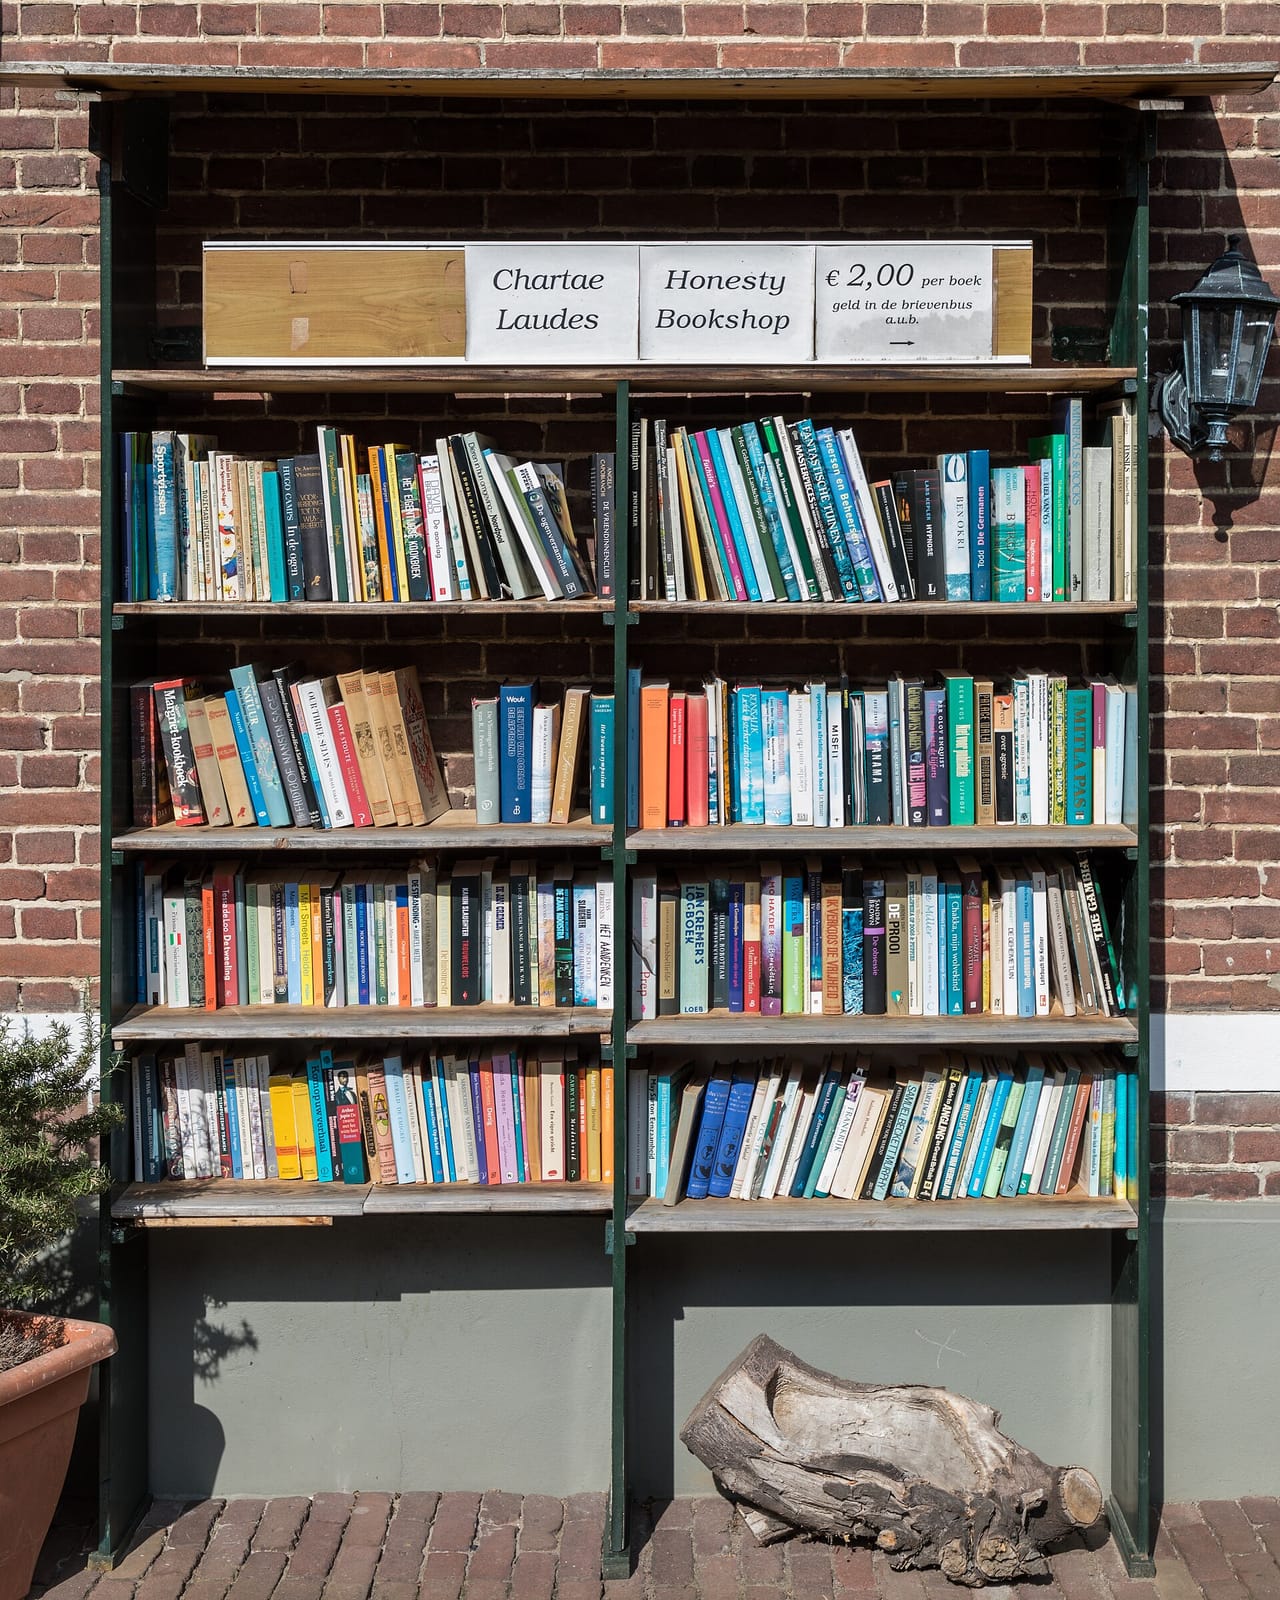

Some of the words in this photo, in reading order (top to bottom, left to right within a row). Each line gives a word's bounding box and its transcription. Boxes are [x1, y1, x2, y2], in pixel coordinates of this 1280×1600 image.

[494, 269, 604, 290] Chartae
[665, 270, 785, 295] Honesty
[825, 270, 839, 286] €
[847, 264, 913, 290] 2,00
[922, 279, 944, 288] per
[950, 276, 981, 285] boek
[496, 308, 598, 329] Laudes
[833, 300, 859, 312] geld
[866, 301, 875, 309] in
[882, 300, 896, 309] de
[902, 300, 972, 309] brievenbus
[656, 309, 789, 334] Bookshop
[886, 315, 918, 324] a.u.b.
[1072, 405, 1080, 458] MINERALS
[156, 446, 167, 515] Sportvissen
[283, 466, 291, 490] HUGO
[403, 477, 412, 491] HET
[703, 459, 716, 488] Fuchsia's
[741, 449, 752, 475] Geldersch
[748, 477, 760, 506] Landschap
[794, 444, 815, 503] MASTERPIECES
[801, 426, 828, 502] FANTASTISCHE
[823, 504, 841, 544] TUINEN
[425, 480, 433, 514] BALDACCI
[431, 480, 441, 513] DAVID
[823, 434, 841, 475] Heersen
[837, 478, 845, 490] en
[841, 493, 861, 546] Beheersen
[1072, 470, 1081, 505] ROCKS
[285, 493, 293, 521] CAMPS
[404, 494, 417, 538] EIGENTIJDSE
[603, 501, 609, 510] DE
[956, 496, 964, 517] BEN
[287, 526, 297, 536] In
[433, 520, 440, 529] De
[1006, 513, 1016, 562] BYRON
[286, 539, 299, 551] de
[435, 531, 443, 559] aanslag
[536, 505, 544, 516] De
[540, 517, 569, 577] ogenverzamelaar
[288, 553, 299, 576] ogen
[410, 541, 420, 579] KOOKBOEK
[977, 550, 985, 568] Todd
[245, 685, 259, 726] NATUUR
[308, 691, 318, 709] OUR
[567, 697, 577, 723] ERICA
[908, 687, 920, 710] GEORGE
[979, 694, 990, 720] PALACE
[311, 711, 323, 737] THREE
[750, 693, 758, 734] KONSALIK
[817, 722, 822, 730] en
[908, 711, 921, 730] DAWES
[163, 690, 188, 787] Margriet-kookboek
[334, 709, 345, 736] RENATE
[340, 737, 352, 763] STOUTE
[564, 725, 572, 748] JONG
[908, 731, 922, 751] GREEN
[980, 722, 990, 743] WALK
[1074, 708, 1086, 770] MITLA
[320, 739, 331, 769] SELVES
[872, 740, 882, 783] PANAMA
[1000, 753, 1008, 779] agressie
[910, 763, 925, 781] THE
[908, 782, 925, 807] JUROR
[1074, 775, 1086, 808] PAS
[496, 886, 504, 894] IK
[496, 895, 504, 904] JAN
[695, 886, 704, 907] JAN
[791, 880, 800, 921] WALTERS
[924, 883, 933, 902] Sue
[578, 900, 586, 928] SLAUGHTER
[685, 886, 694, 944] LOGBOEK
[827, 900, 838, 909] IK
[889, 904, 900, 918] DE
[951, 901, 960, 932] Chakka,
[496, 906, 504, 931] CREMER
[600, 924, 610, 939] HET
[827, 910, 838, 944] VERKOOS
[925, 904, 934, 939] Miller
[1090, 913, 1103, 941] THE
[695, 910, 704, 964] CREMER'S
[873, 936, 879, 947] De
[889, 921, 900, 955] PROOI
[951, 934, 959, 952] mijn
[599, 941, 611, 987] AANDENKEN
[827, 948, 838, 958] DE
[637, 971, 650, 996] Prep
[827, 961, 838, 999] VRIJHEID
[952, 953, 960, 992] wolvekind
[900, 1085, 916, 1117] SAMUEL
[946, 1097, 952, 1105] to
[948, 1082, 956, 1097] Guide
[834, 1107, 854, 1153] FRANKRIJK
[935, 1103, 952, 1141] ANGLING
[648, 1117, 656, 1160] Eenzaamheid
[754, 1122, 766, 1153] VOSJE
[890, 1118, 907, 1156] BECKETT
[932, 1146, 940, 1161] Great
[877, 1156, 891, 1190] MURPHY
[927, 1162, 937, 1180] Britain
